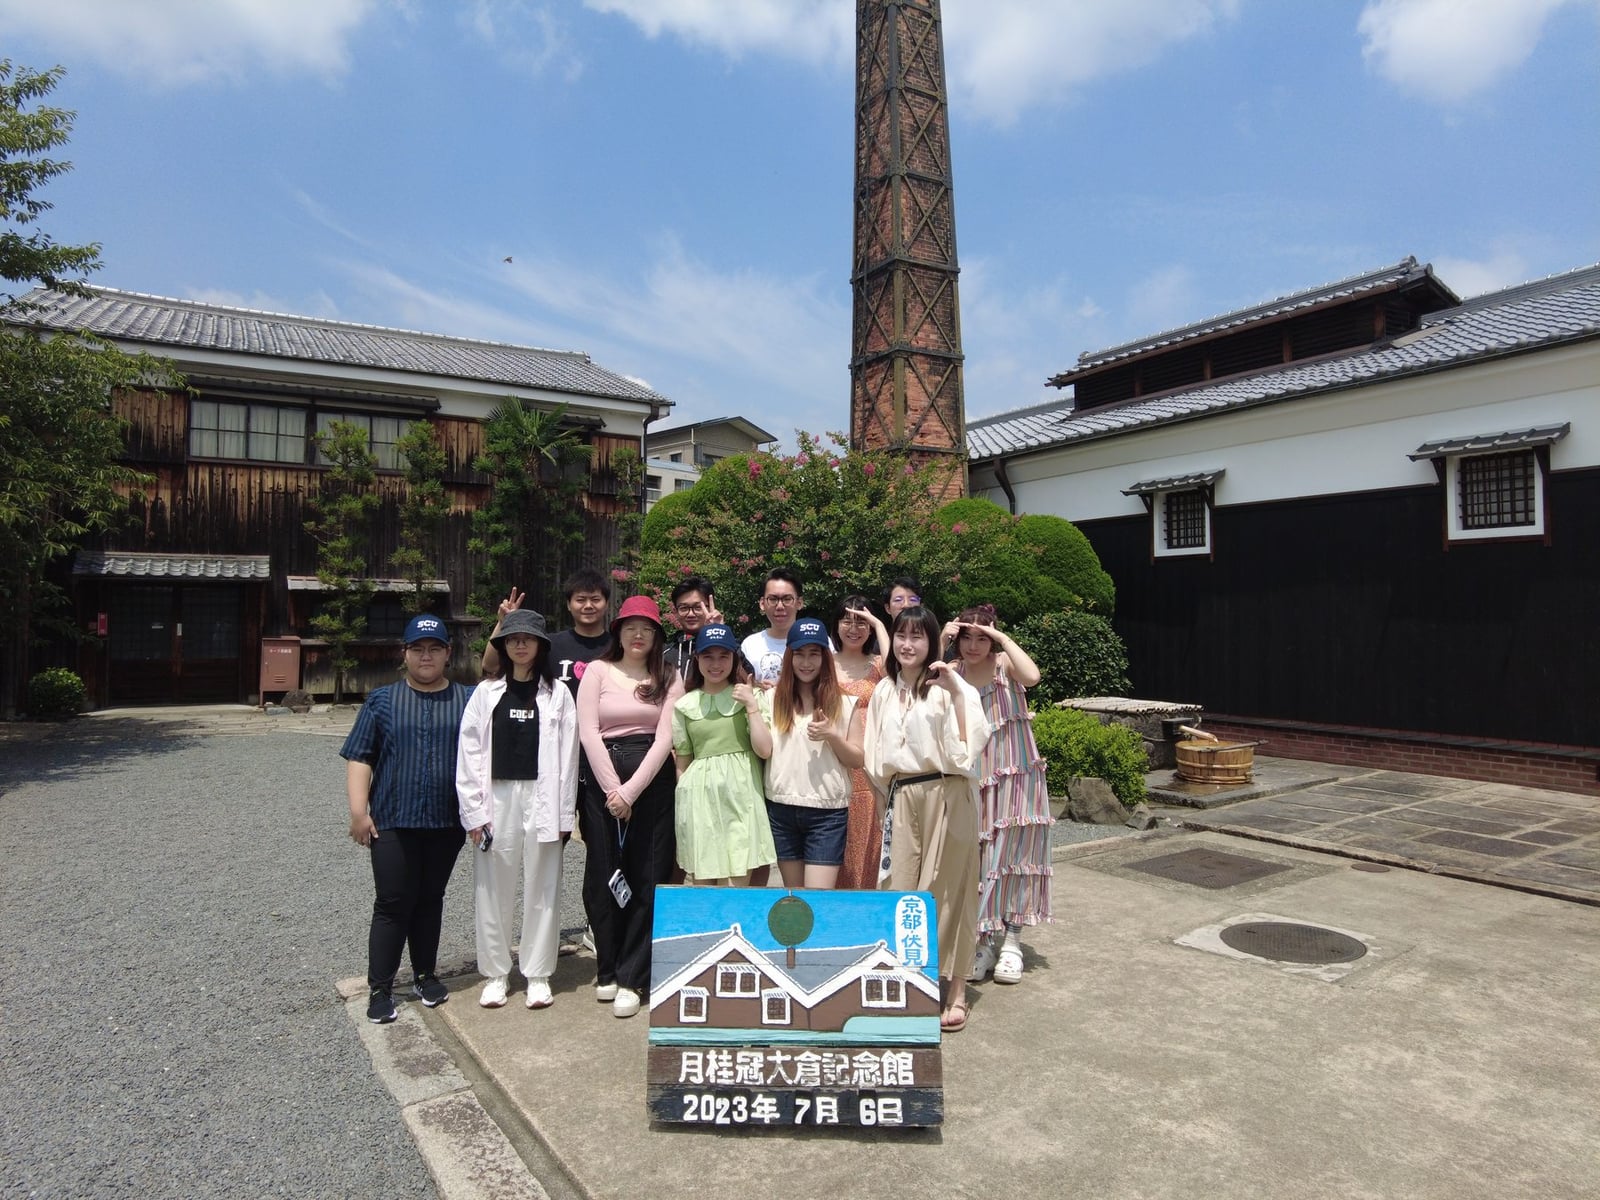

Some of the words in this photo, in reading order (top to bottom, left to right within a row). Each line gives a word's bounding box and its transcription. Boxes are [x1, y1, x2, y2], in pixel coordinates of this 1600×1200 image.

[416, 619, 438, 628] SCU
[799, 623, 820, 632] SCU
[705, 628, 726, 636] SCU
[558, 659, 574, 682] I
[678, 1049, 915, 1087] 月桂冠大倉記念館
[682, 1093, 781, 1125] 2023年
[794, 1096, 839, 1125] 7月
[859, 1098, 904, 1126] 6日
